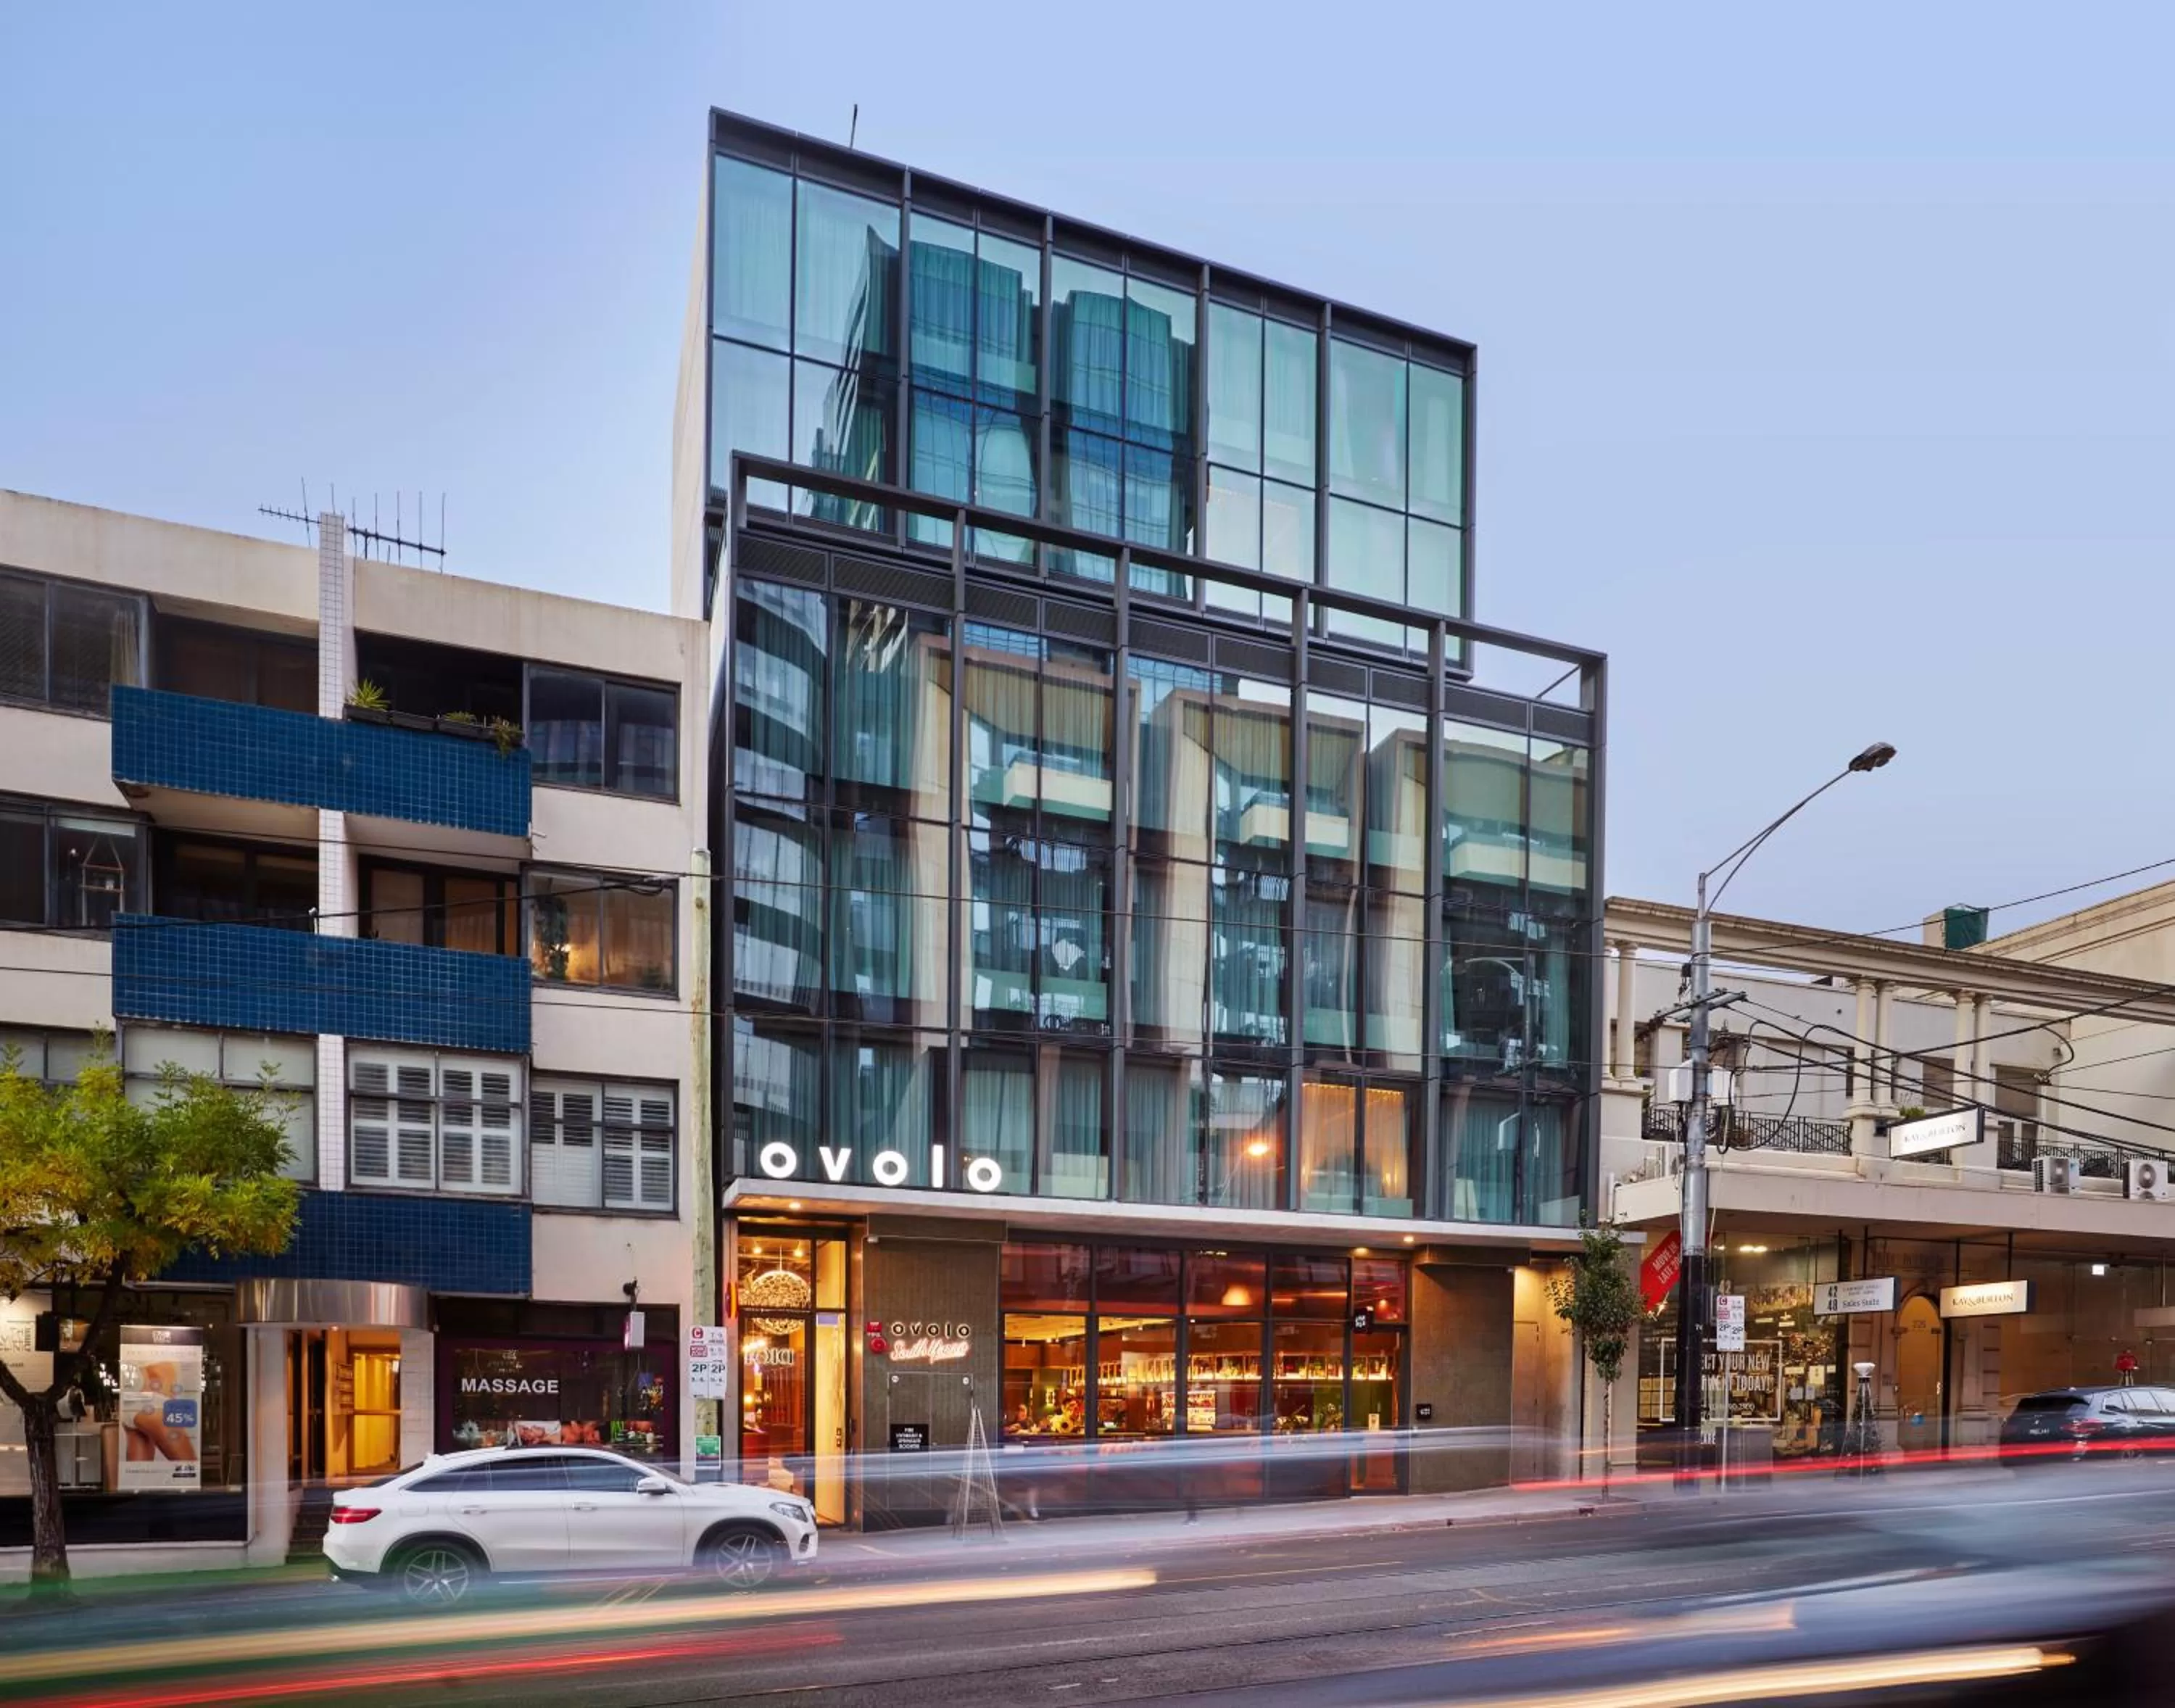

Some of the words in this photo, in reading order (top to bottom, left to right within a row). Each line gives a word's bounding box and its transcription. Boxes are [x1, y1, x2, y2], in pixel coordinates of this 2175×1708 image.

[1653, 1248, 1672, 1272] MOVE
[1828, 1285, 1838, 1297] 42
[1748, 1353, 1770, 1371] NEW
[692, 1364, 708, 1373] 2P
[711, 1364, 726, 1374] 2P
[461, 1378, 559, 1393] MASSAGE
[167, 1412, 194, 1423] 45%
